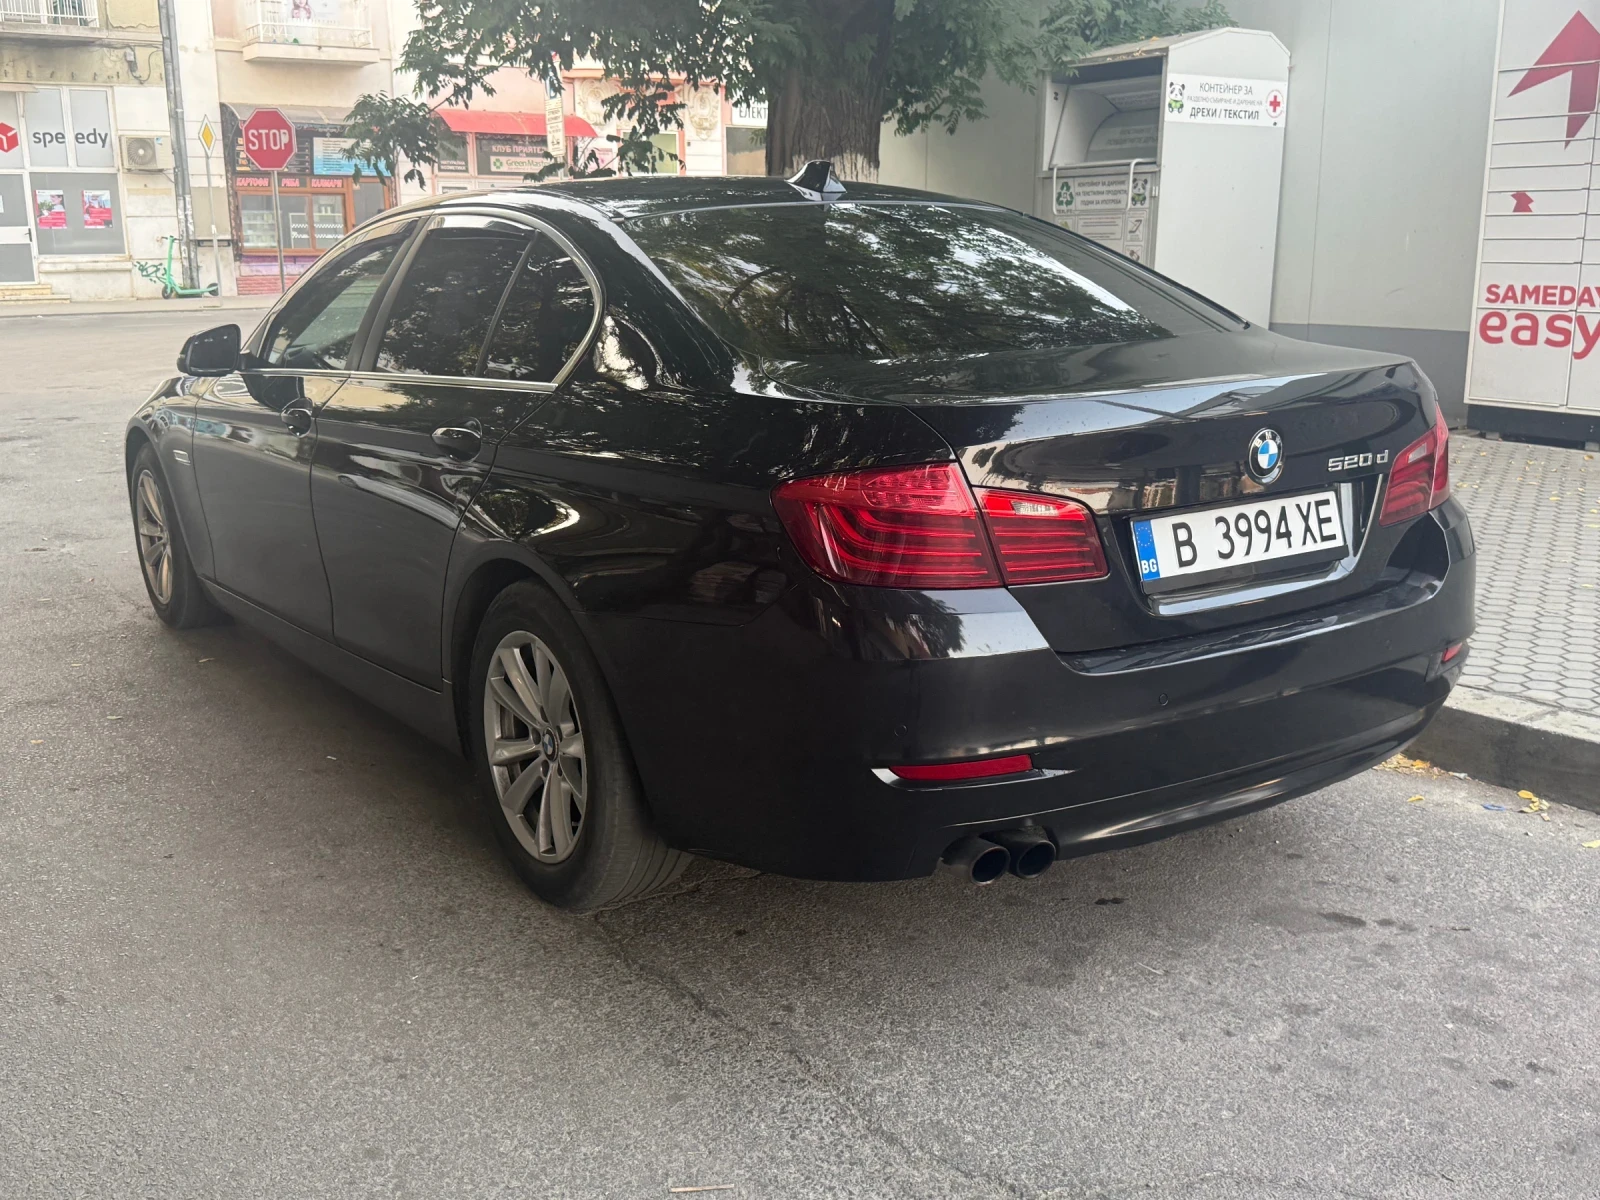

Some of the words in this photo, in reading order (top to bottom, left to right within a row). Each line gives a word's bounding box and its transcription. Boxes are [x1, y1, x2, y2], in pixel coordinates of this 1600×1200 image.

[1199, 82, 1243, 95] КОНТЕЙНЕР
[1243, 85, 1253, 96] ЗА
[1189, 106, 1217, 119] ДРЕХИ
[1223, 108, 1259, 120] ТЕКСТИЛ
[32, 127, 108, 148] speedy
[248, 129, 290, 150] STOP
[491, 145, 512, 153] КЛУБ
[505, 158, 549, 168] GreenMaste
[1479, 311, 1600, 360] easy
[1172, 522, 1198, 569] B
[1141, 558, 1158, 574] BG
